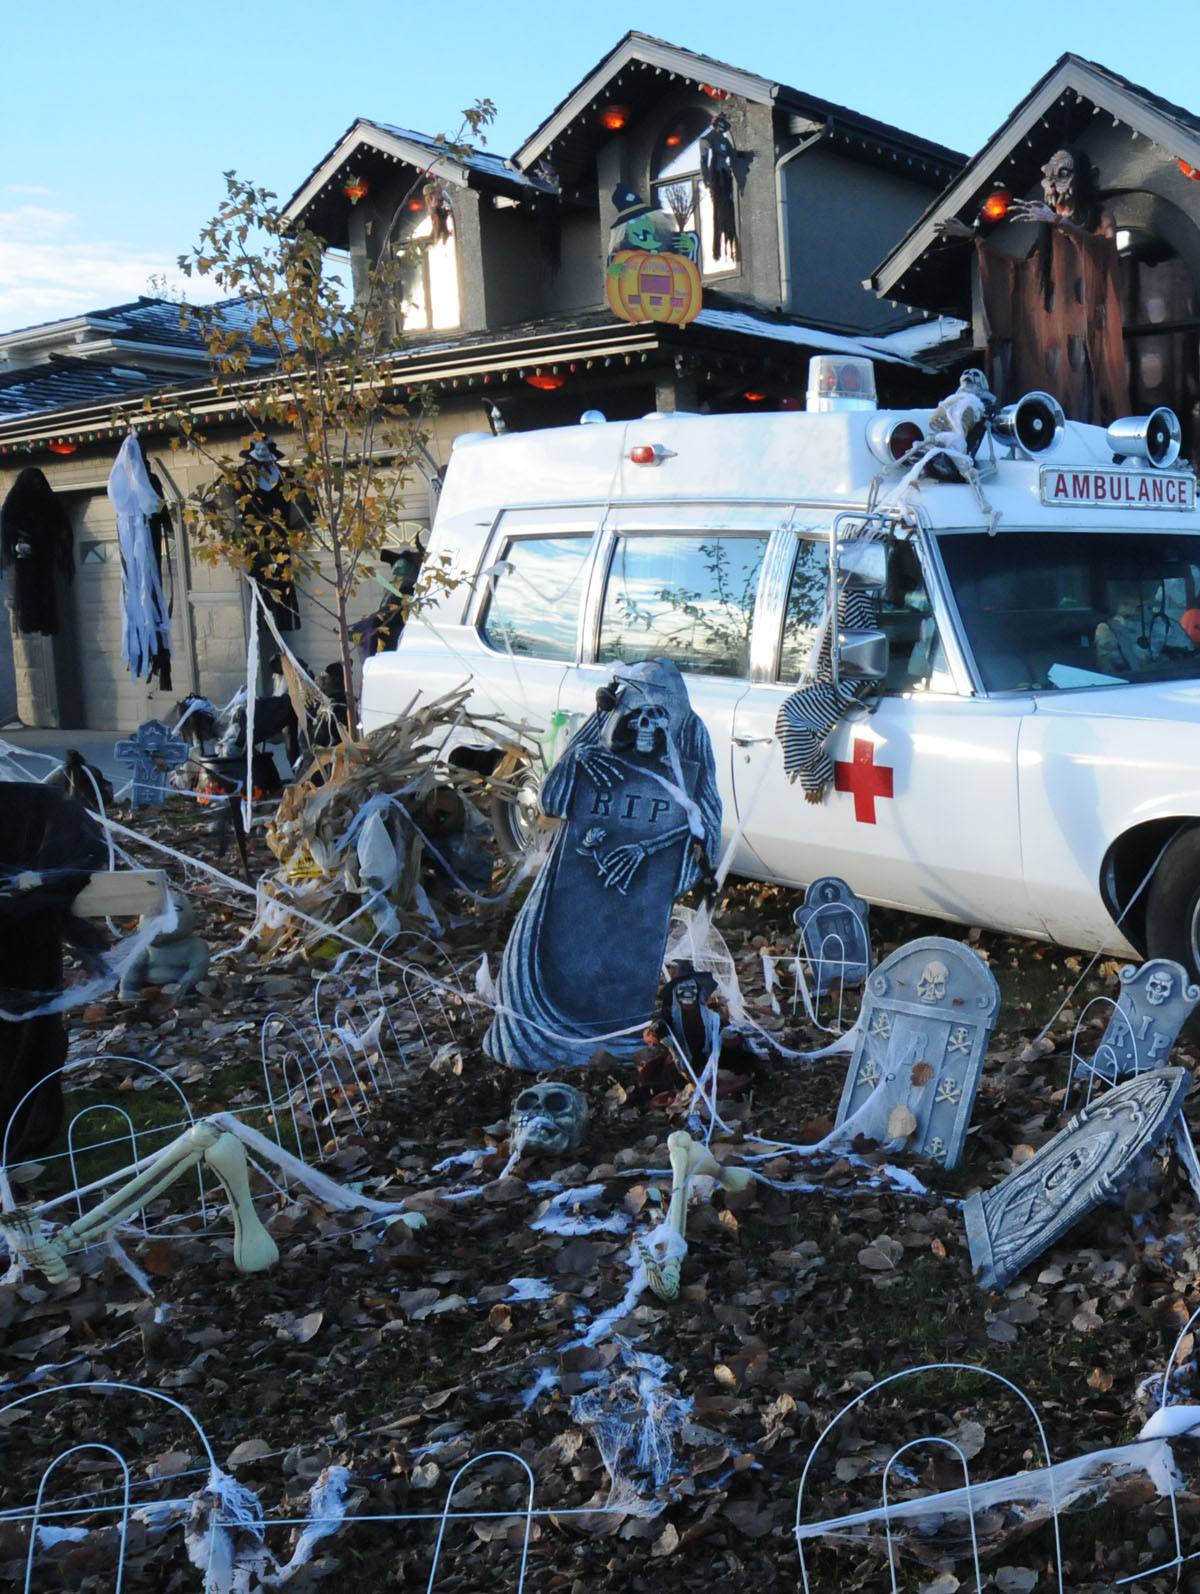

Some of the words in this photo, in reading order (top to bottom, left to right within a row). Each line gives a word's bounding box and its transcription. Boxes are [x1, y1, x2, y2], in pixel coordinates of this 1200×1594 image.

[1054, 473, 1187, 504] AMBULANCE
[590, 789, 671, 824] RIP
[1106, 1015, 1172, 1058] RIP
